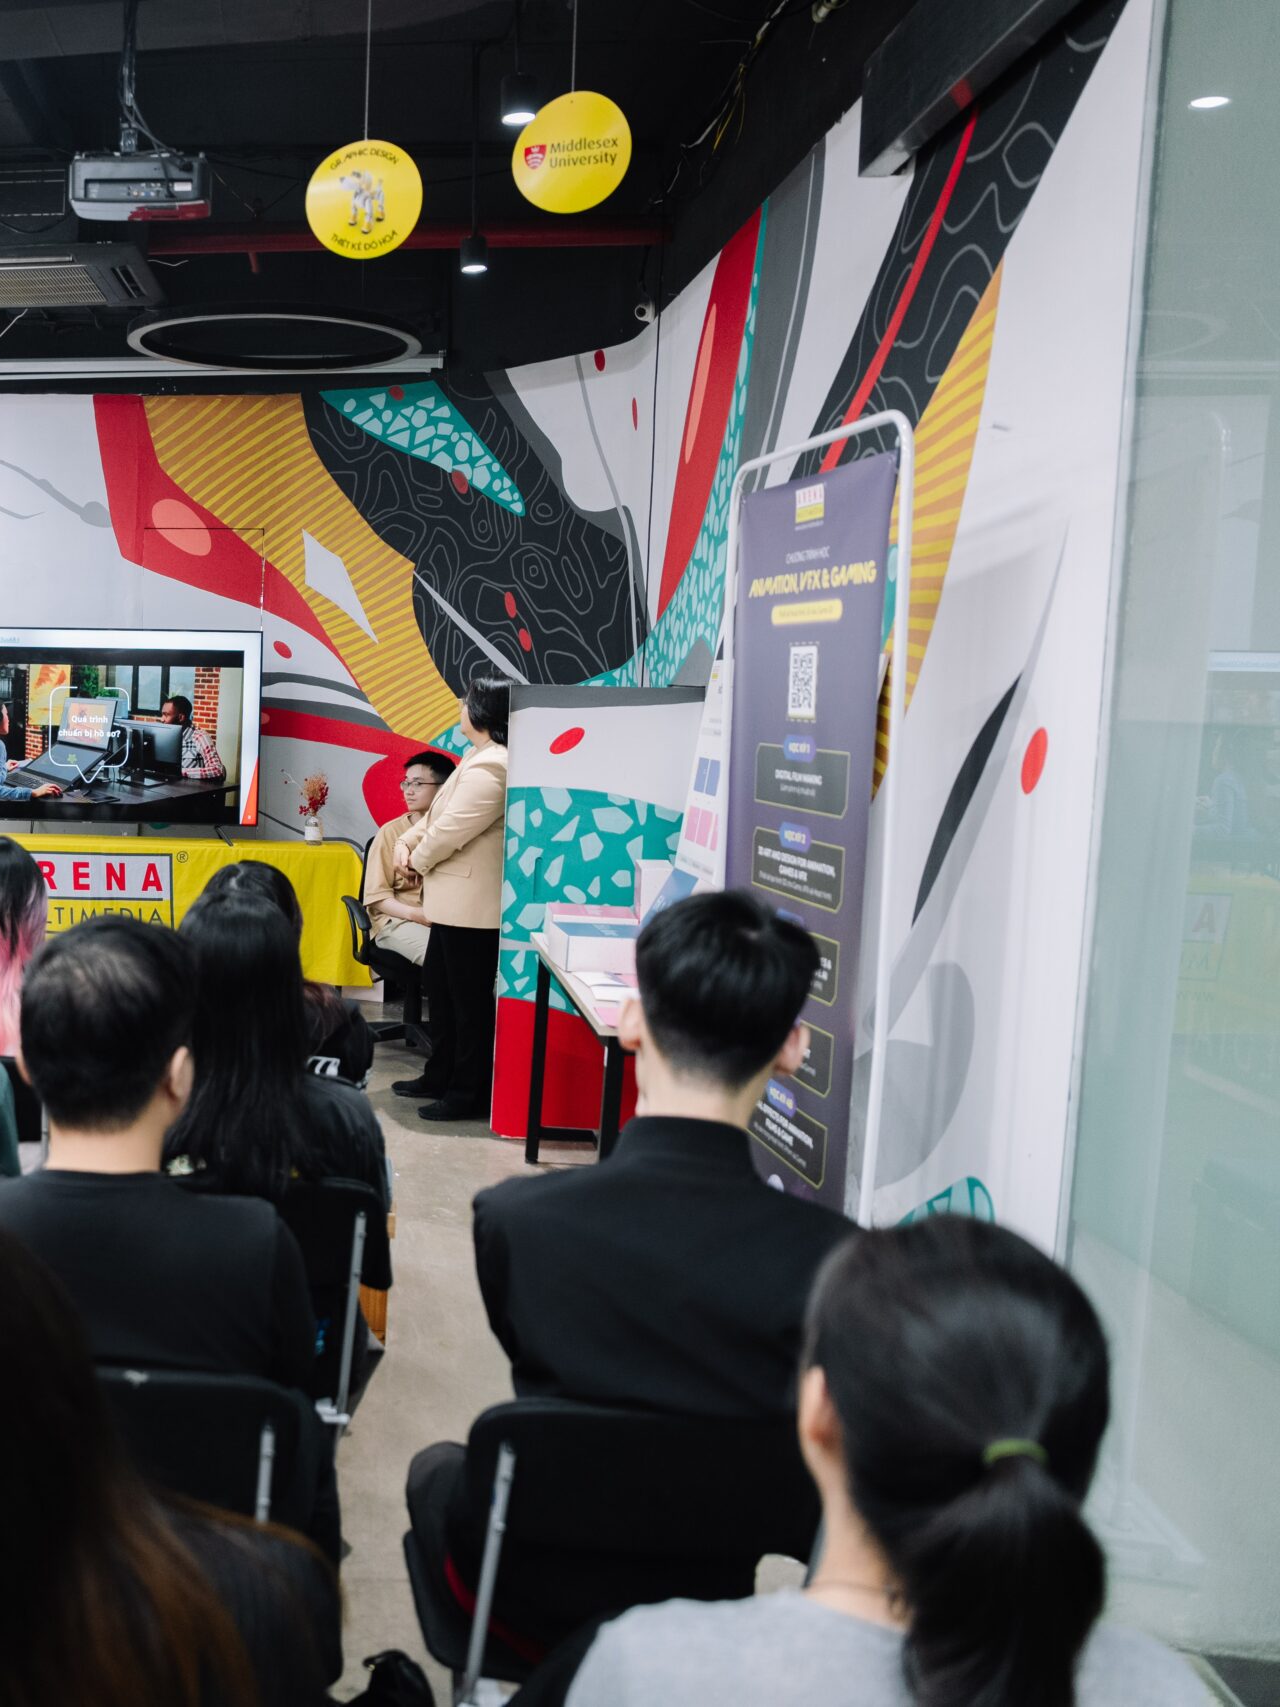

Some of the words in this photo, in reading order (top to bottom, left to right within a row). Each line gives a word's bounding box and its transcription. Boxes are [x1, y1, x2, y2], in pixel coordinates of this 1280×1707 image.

[549, 137, 619, 154] Middlesex
[369, 148, 400, 165] DESIGN
[549, 151, 618, 169] University
[748, 573, 799, 599] ANIMATION,
[799, 568, 821, 592] VFX
[830, 559, 877, 588] GAMING
[35, 860, 164, 891] RENA
